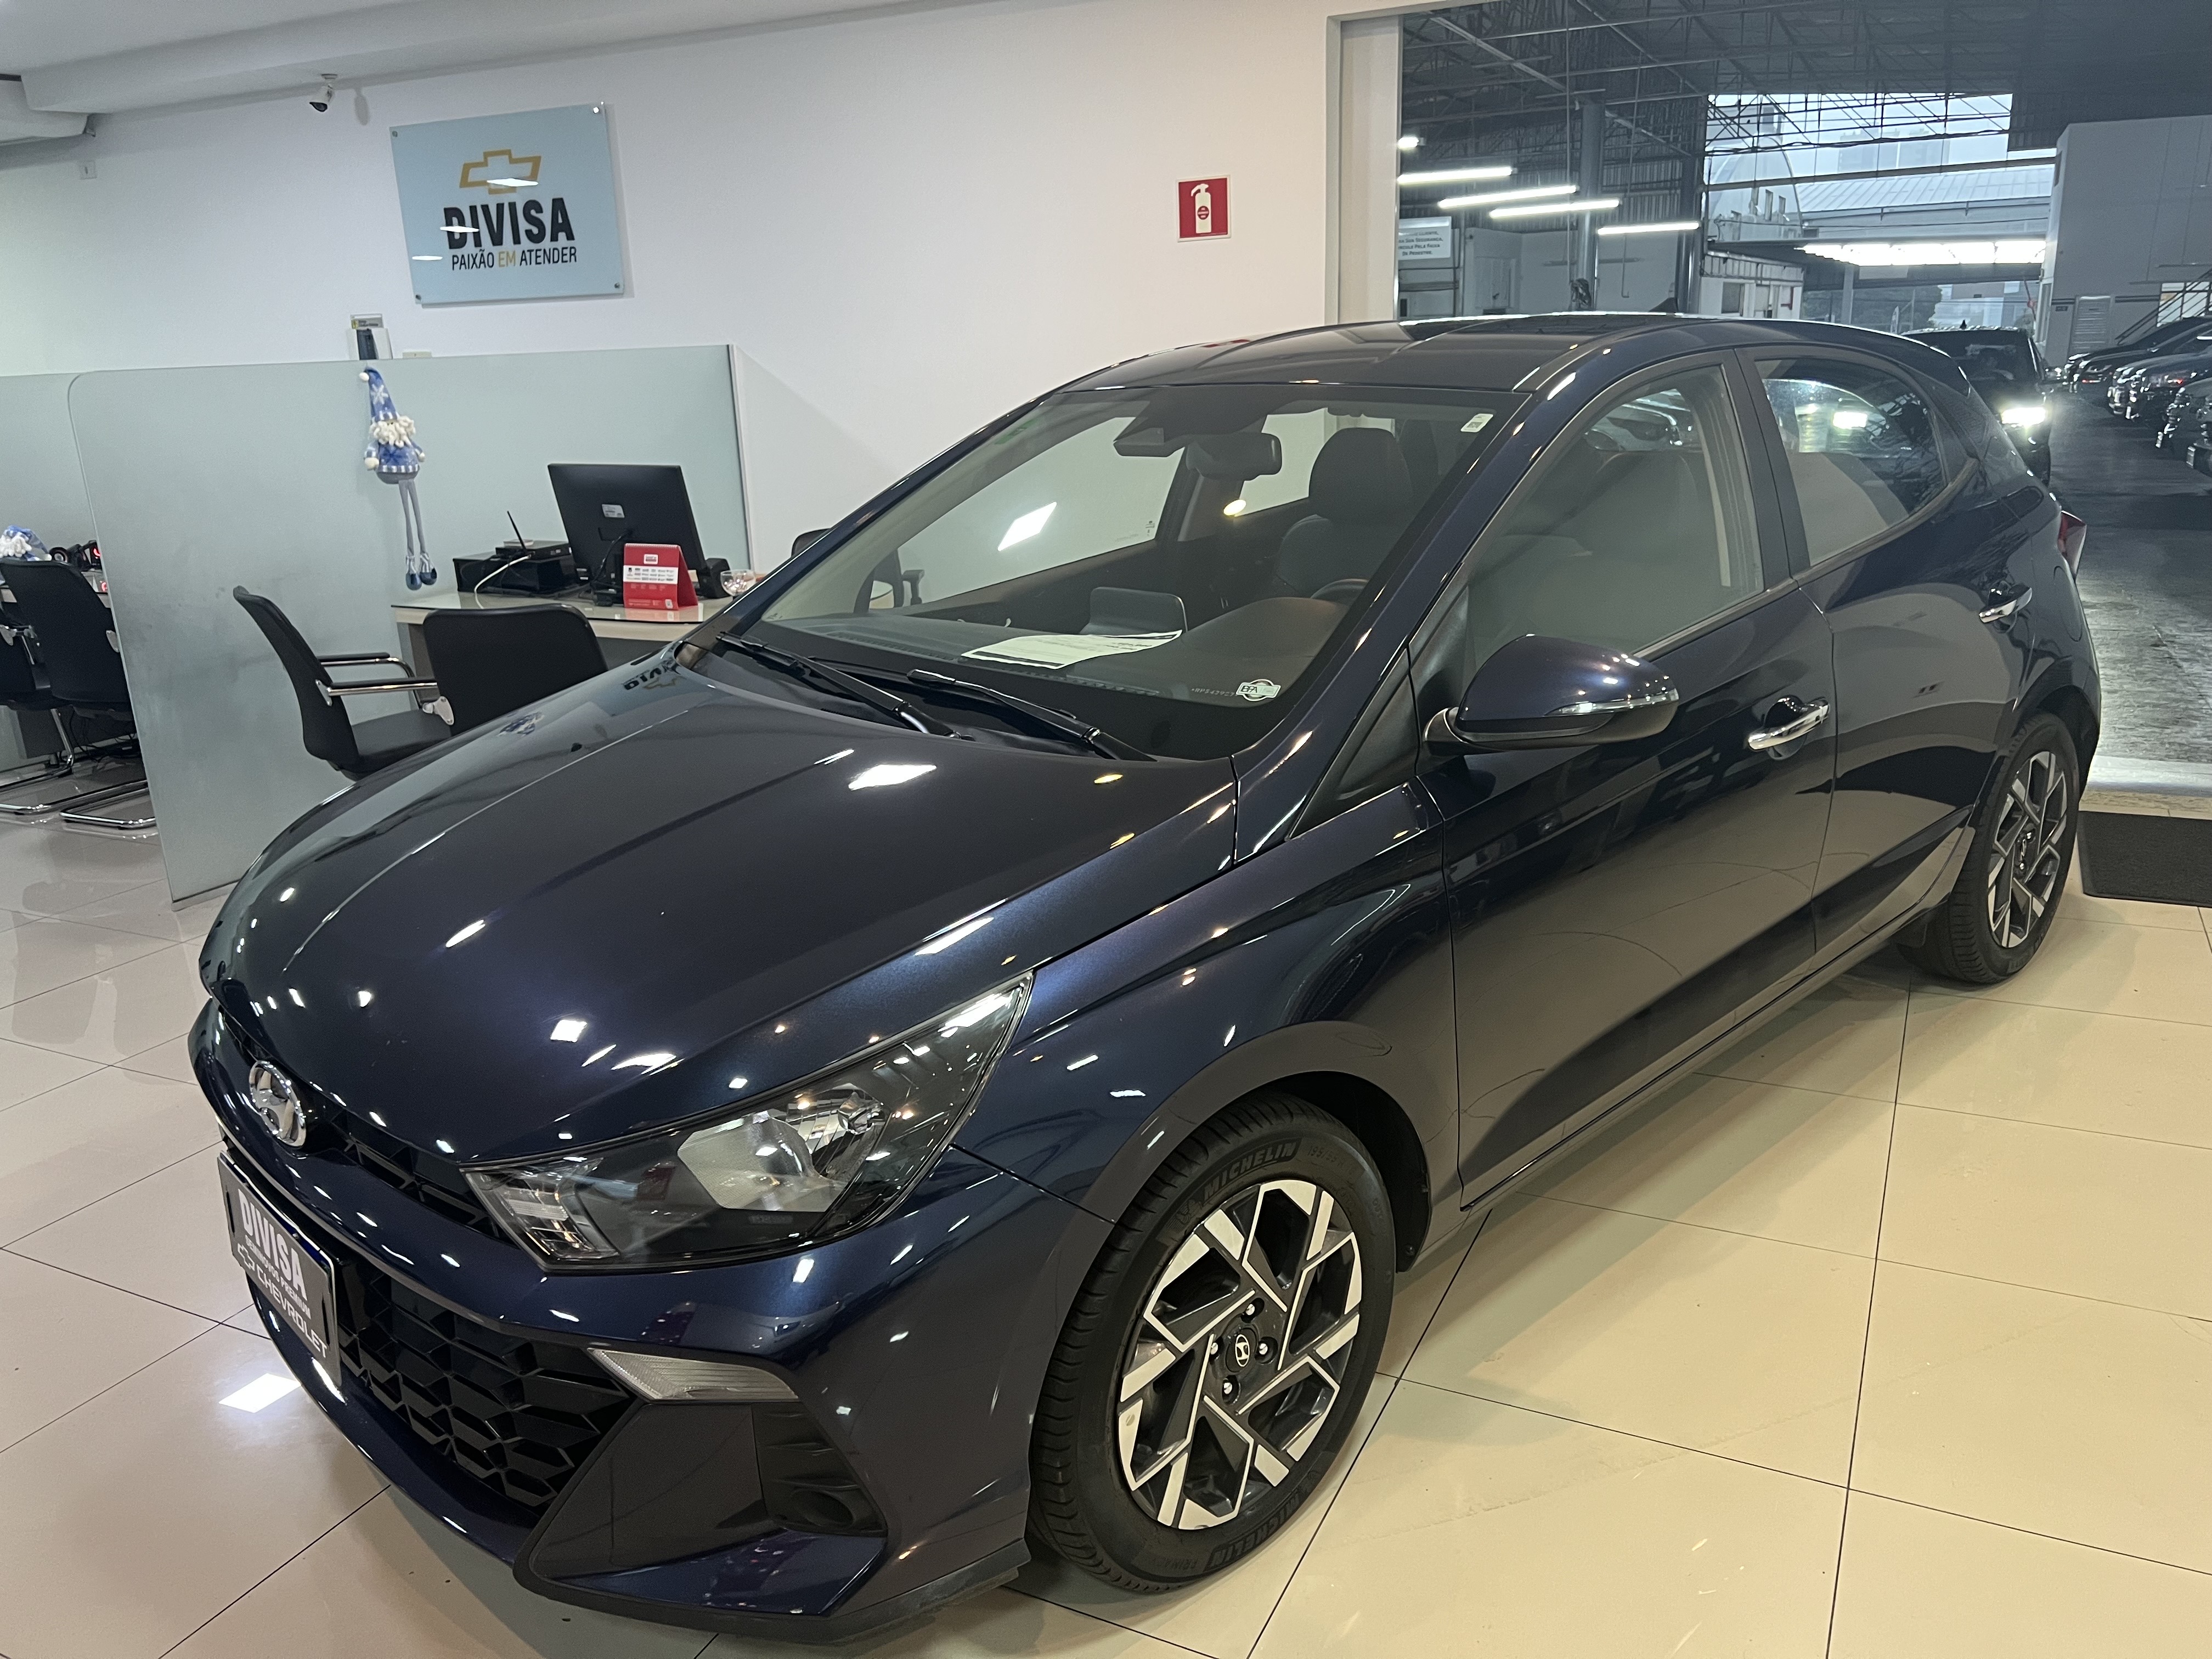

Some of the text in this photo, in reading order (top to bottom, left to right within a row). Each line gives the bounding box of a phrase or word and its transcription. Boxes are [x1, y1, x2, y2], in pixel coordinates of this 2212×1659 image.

[443, 198, 575, 249] DIVISA
[452, 246, 577, 271] PAIXÃO EM ATENDER
[1204, 1142, 1297, 1201] MICHELIN
[238, 1188, 308, 1301] DIVISA
[256, 1263, 328, 1358] CHEVROLET
[280, 1276, 312, 1320] PREMIUM
[1211, 1492, 1300, 1567] MICHELIN
